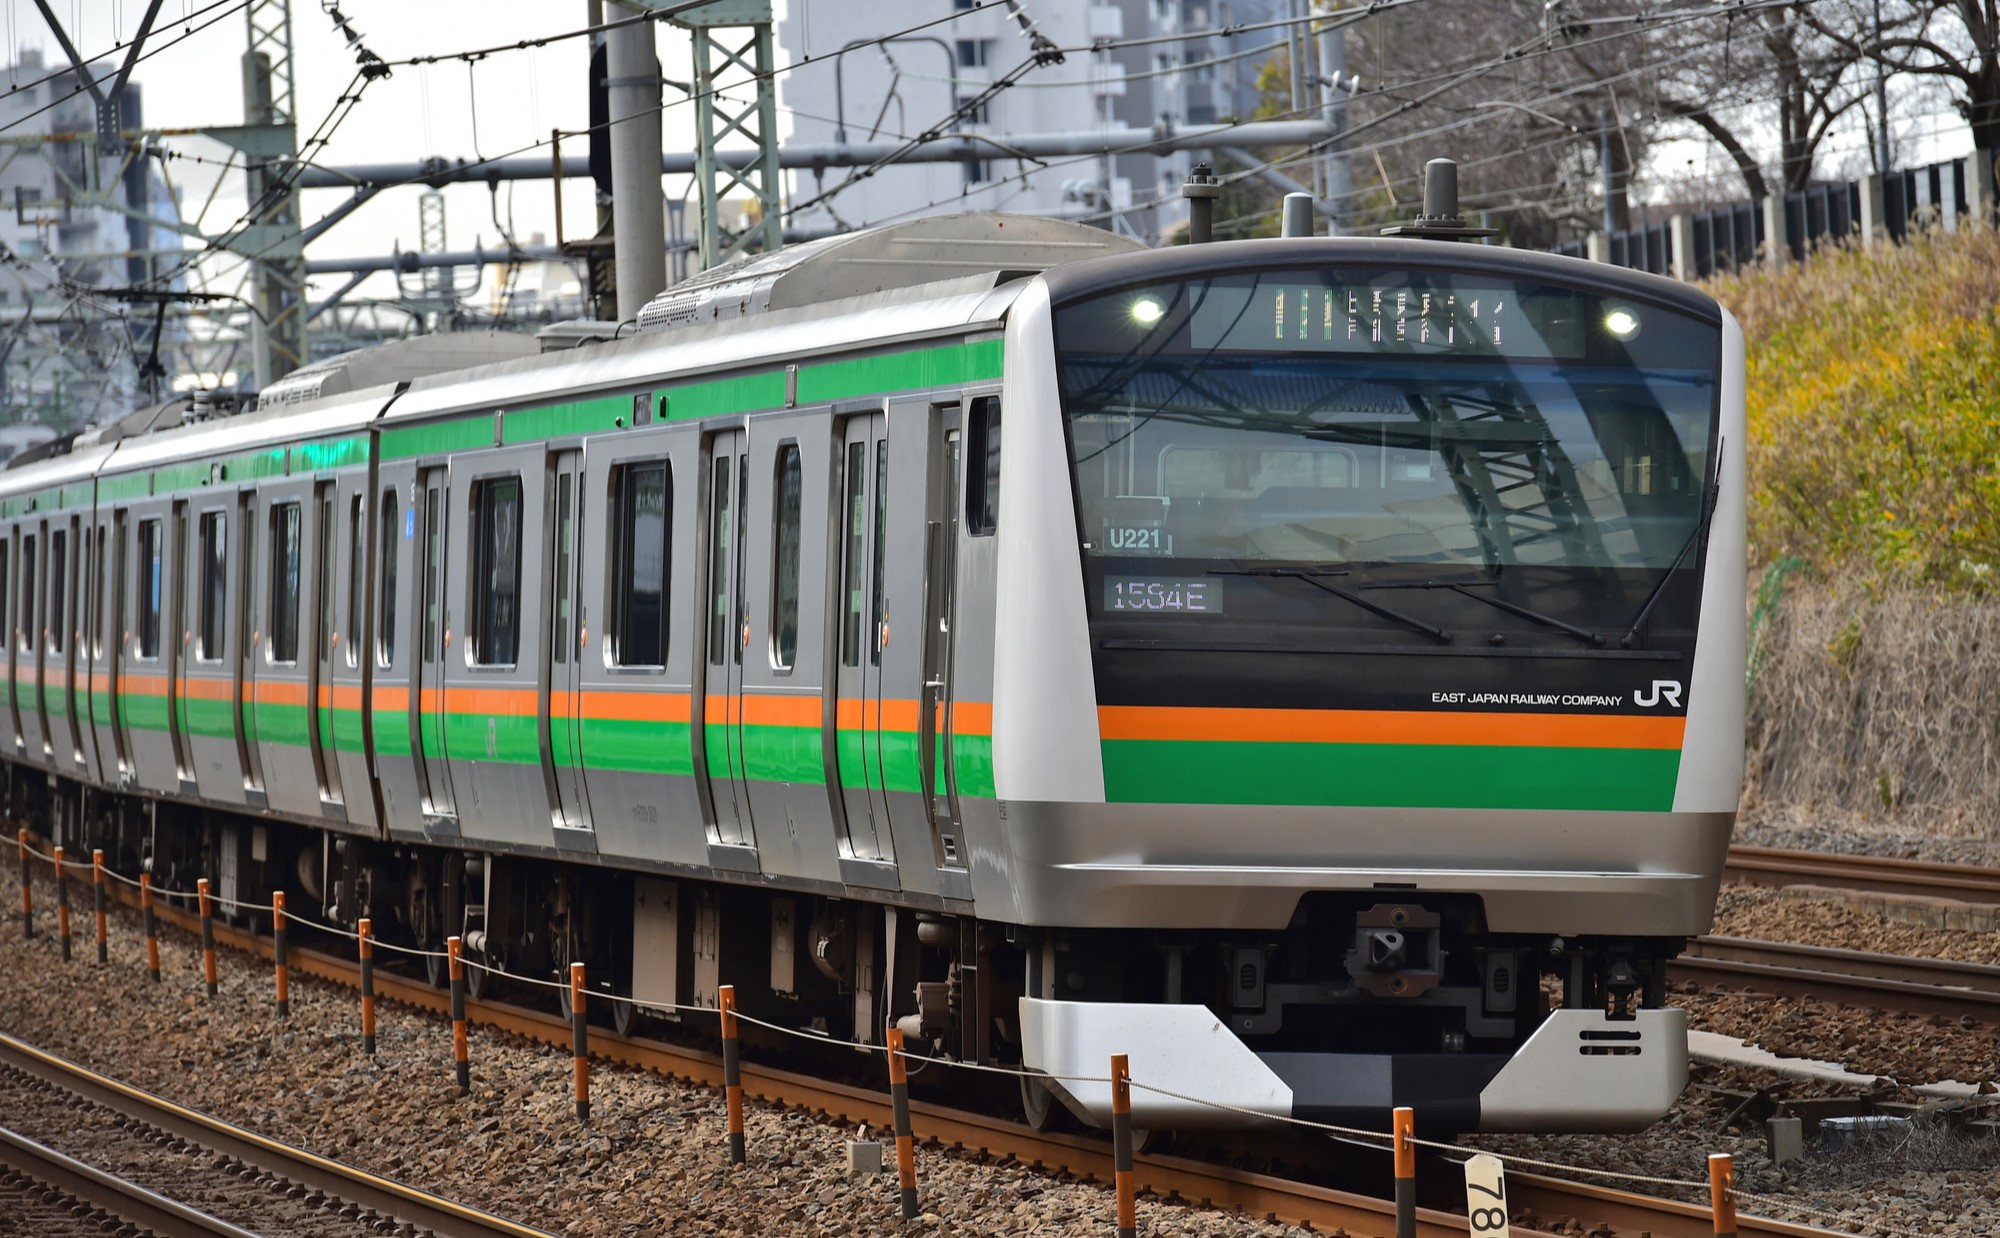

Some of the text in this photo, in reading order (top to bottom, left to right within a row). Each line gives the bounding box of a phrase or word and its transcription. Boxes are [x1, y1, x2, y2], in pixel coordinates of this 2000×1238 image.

[1110, 528, 1160, 548] U221
[1432, 692, 1622, 706] EAST JAPAN RAILWAY COMPANY
[1634, 680, 1682, 708] JR
[1468, 1176, 1505, 1238] 78
